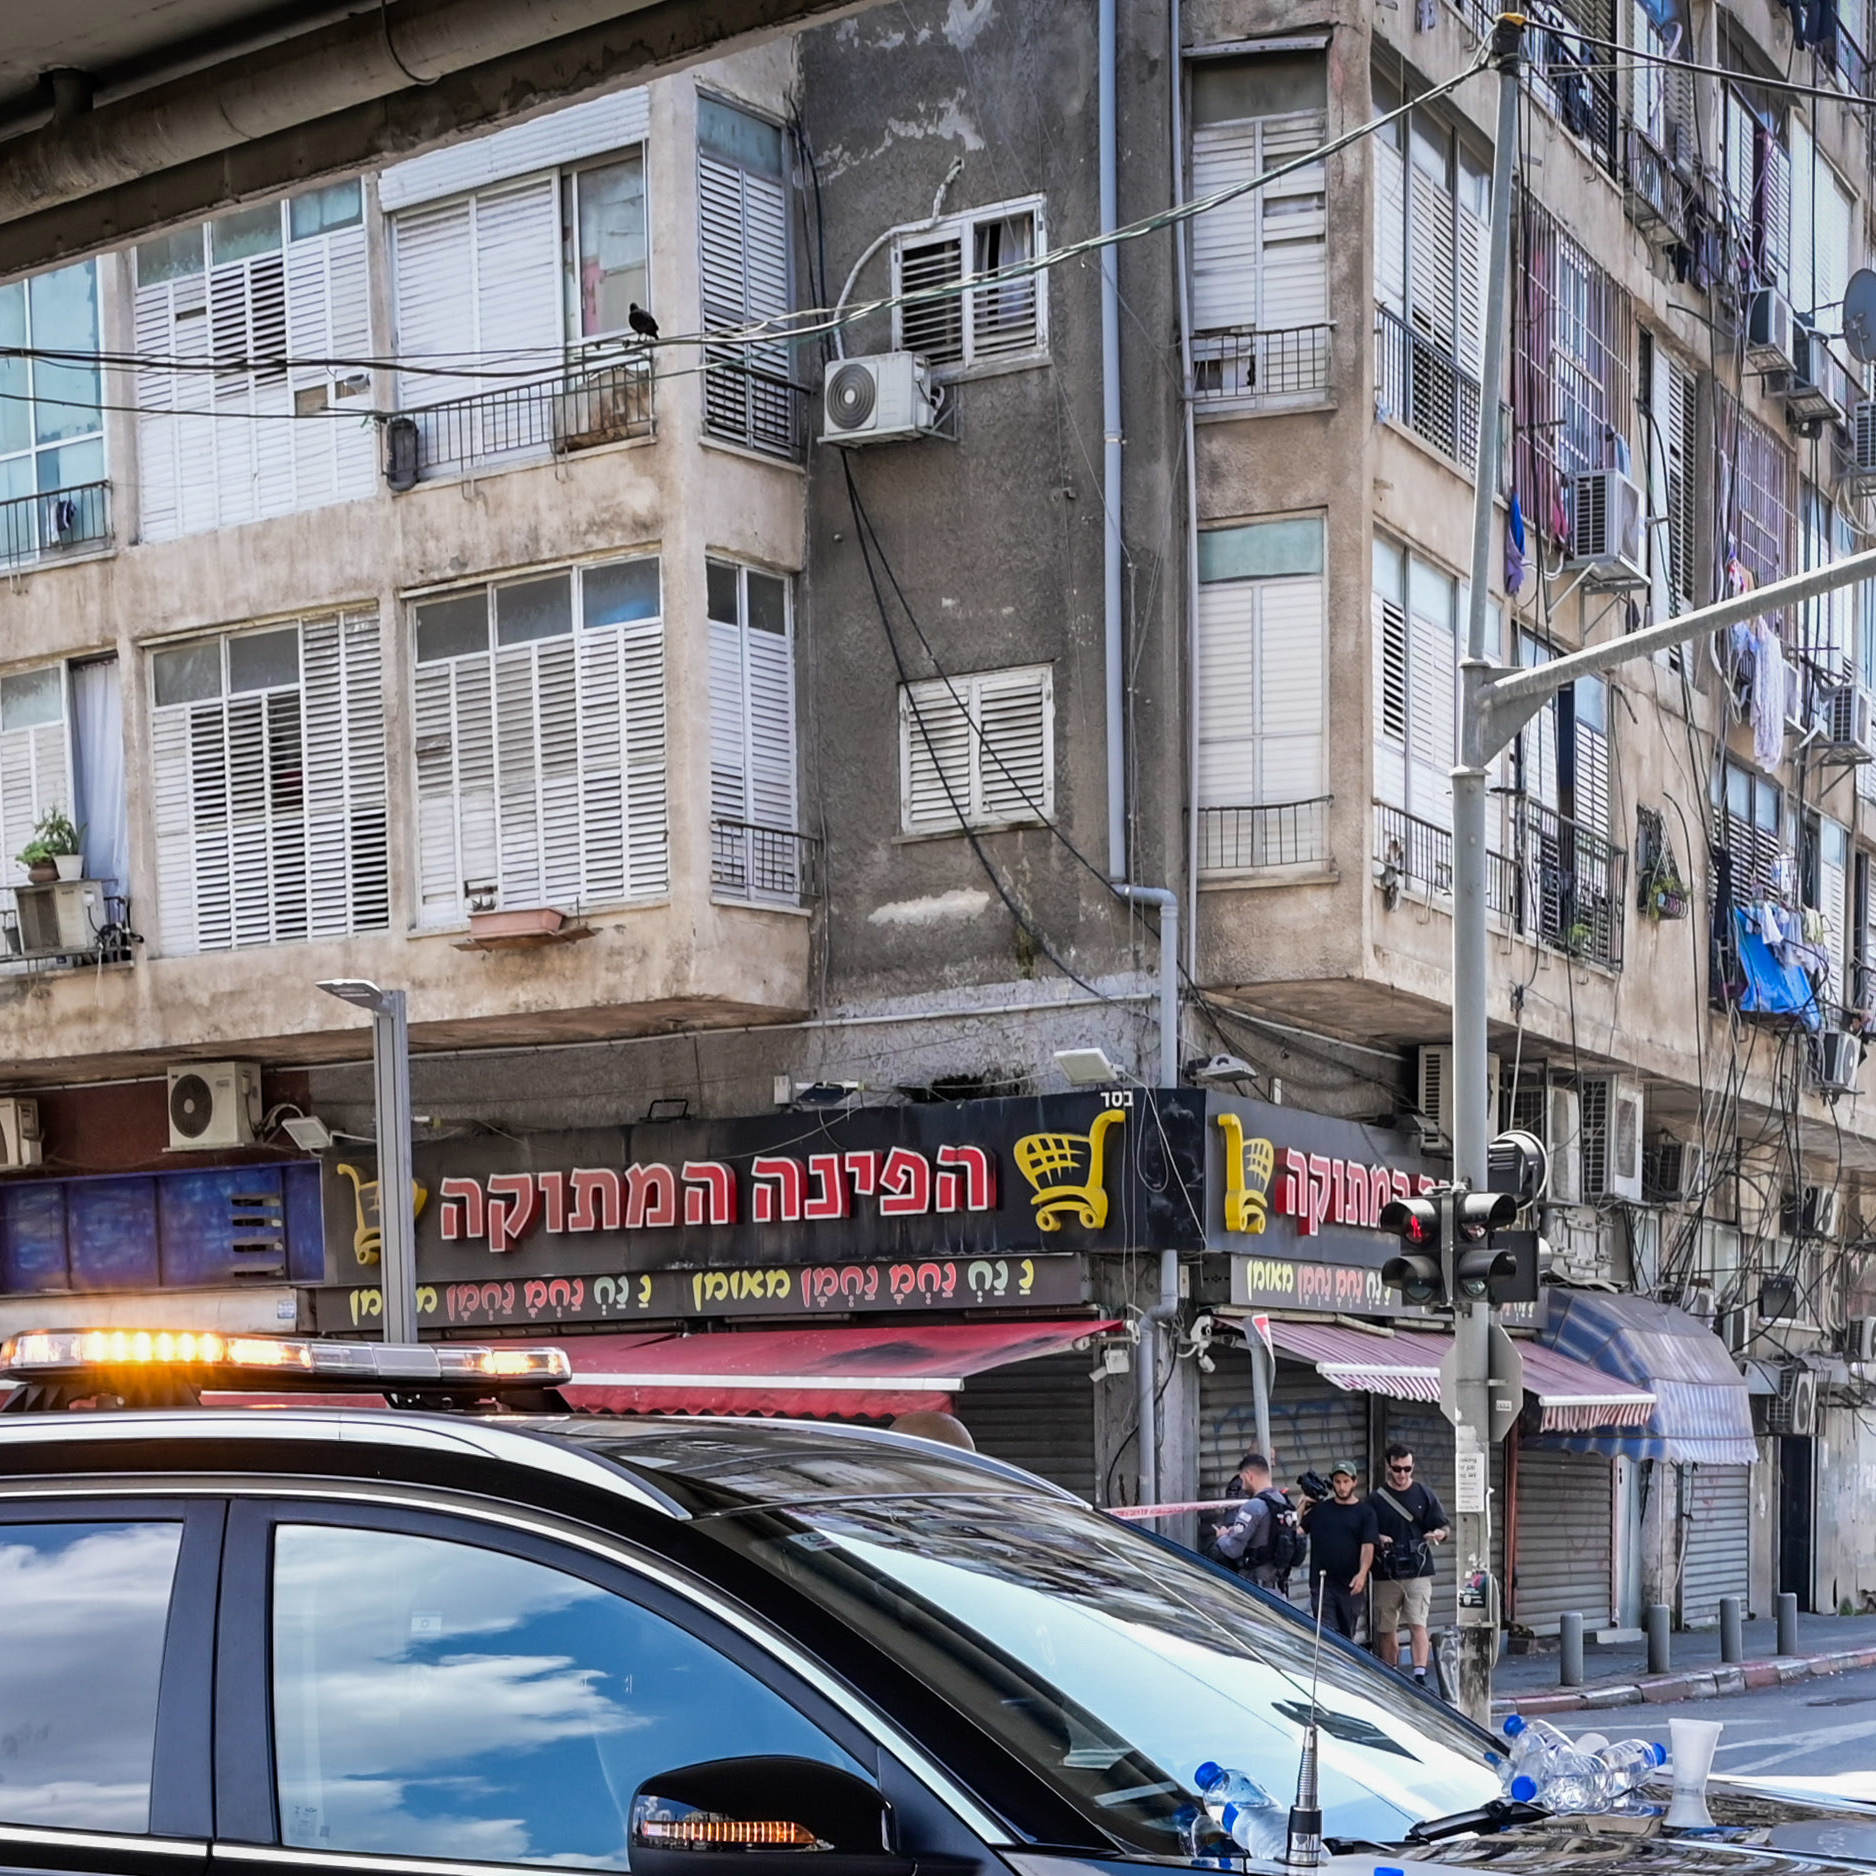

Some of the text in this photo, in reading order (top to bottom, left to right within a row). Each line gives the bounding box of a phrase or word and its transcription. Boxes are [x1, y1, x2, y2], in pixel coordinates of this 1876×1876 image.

[1100, 1091, 1133, 1108] בסד
[439, 1144, 995, 1252] הפינה המתוקה
[692, 1269, 791, 1312] מאומן
[1247, 1260, 1294, 1301] מאומן
